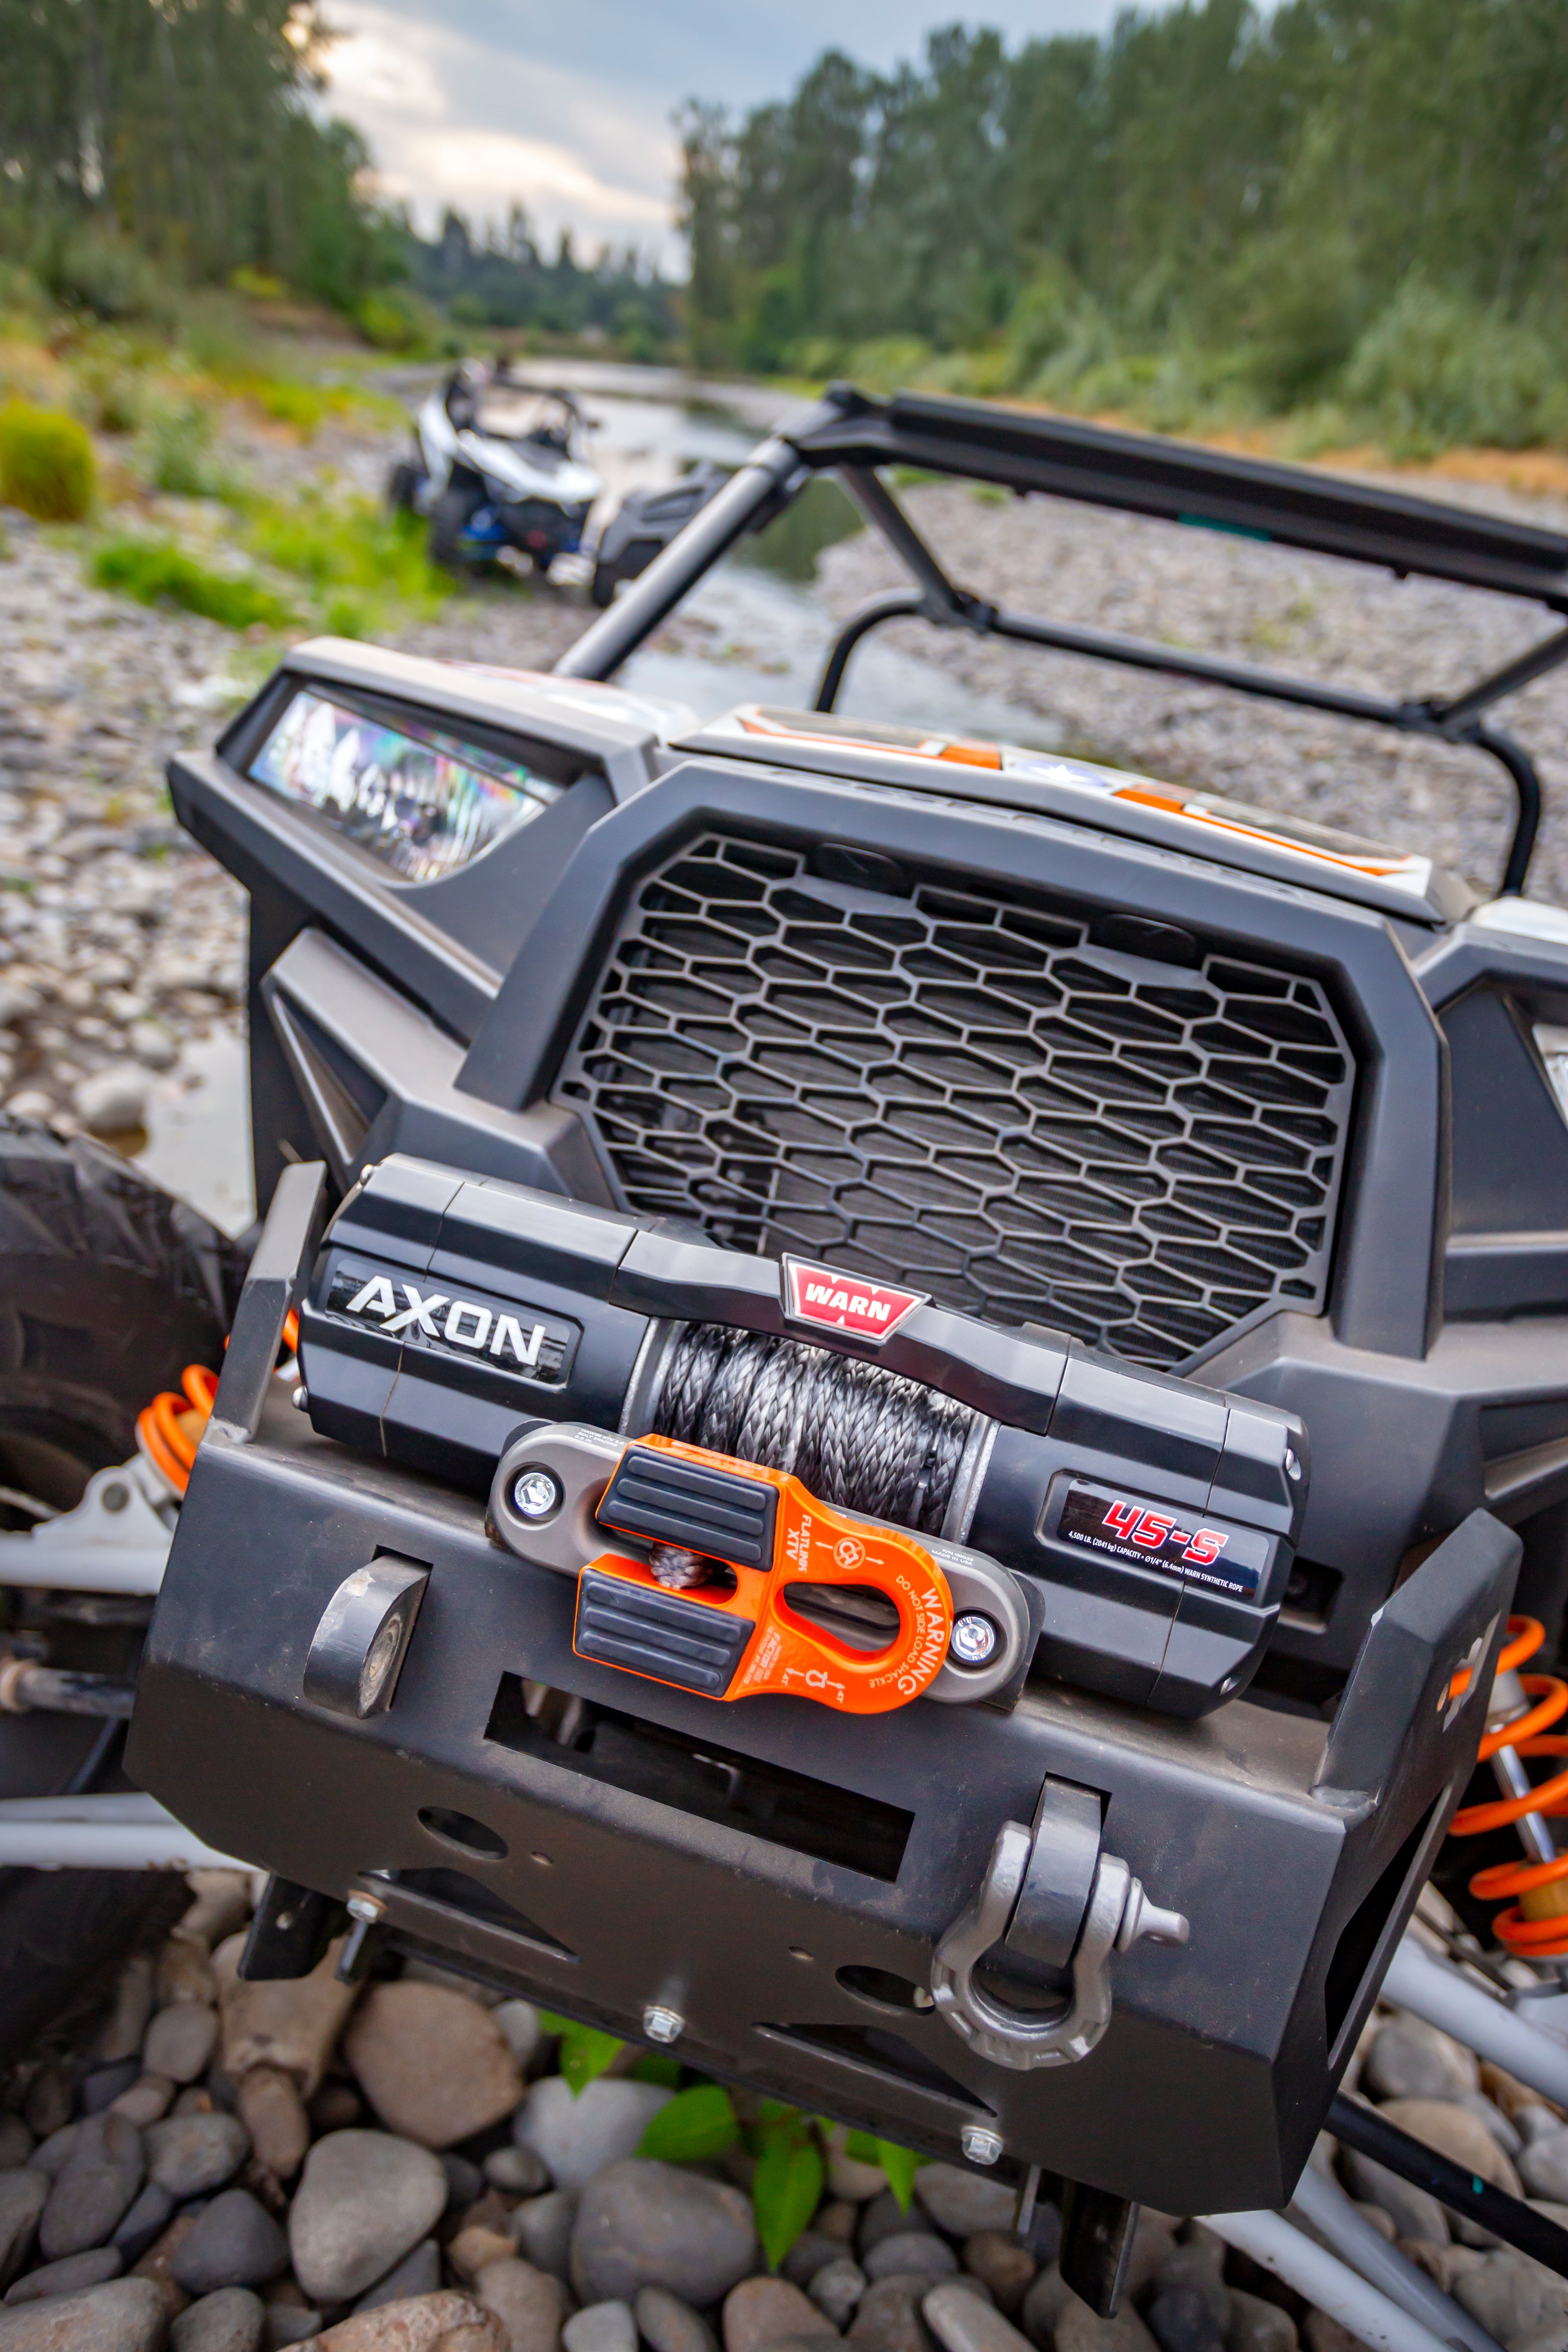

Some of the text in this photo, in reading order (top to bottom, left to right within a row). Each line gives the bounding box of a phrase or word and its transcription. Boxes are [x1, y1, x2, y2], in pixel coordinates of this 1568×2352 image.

[345, 1275, 546, 1366] AXON
[805, 1283, 891, 1321] WARN
[581, 1429, 601, 1437] HAWSE
[593, 1437, 618, 1447] SPACING
[786, 1527, 800, 1561] XTV
[798, 1514, 812, 1572] FLATLINK
[931, 1549, 951, 1559] MADE
[1101, 1499, 1229, 1566] 45-S
[1068, 1530, 1083, 1541] 4,500
[1092, 1537, 1108, 1548] (2041
[1108, 1543, 1117, 1552] kg)
[1116, 1546, 1141, 1559] CAPACITY
[1162, 1560, 1184, 1574] (6.4mm)
[1184, 1568, 1201, 1579] WARN
[1200, 1573, 1229, 1588] SYNTHETIC
[1228, 1582, 1243, 1592] ROPE
[760, 1632, 780, 1668] FACTOR
[869, 1575, 925, 1688] DO NOT SIDE LOAD SHACKLE
[898, 1587, 944, 1695] WARNING
